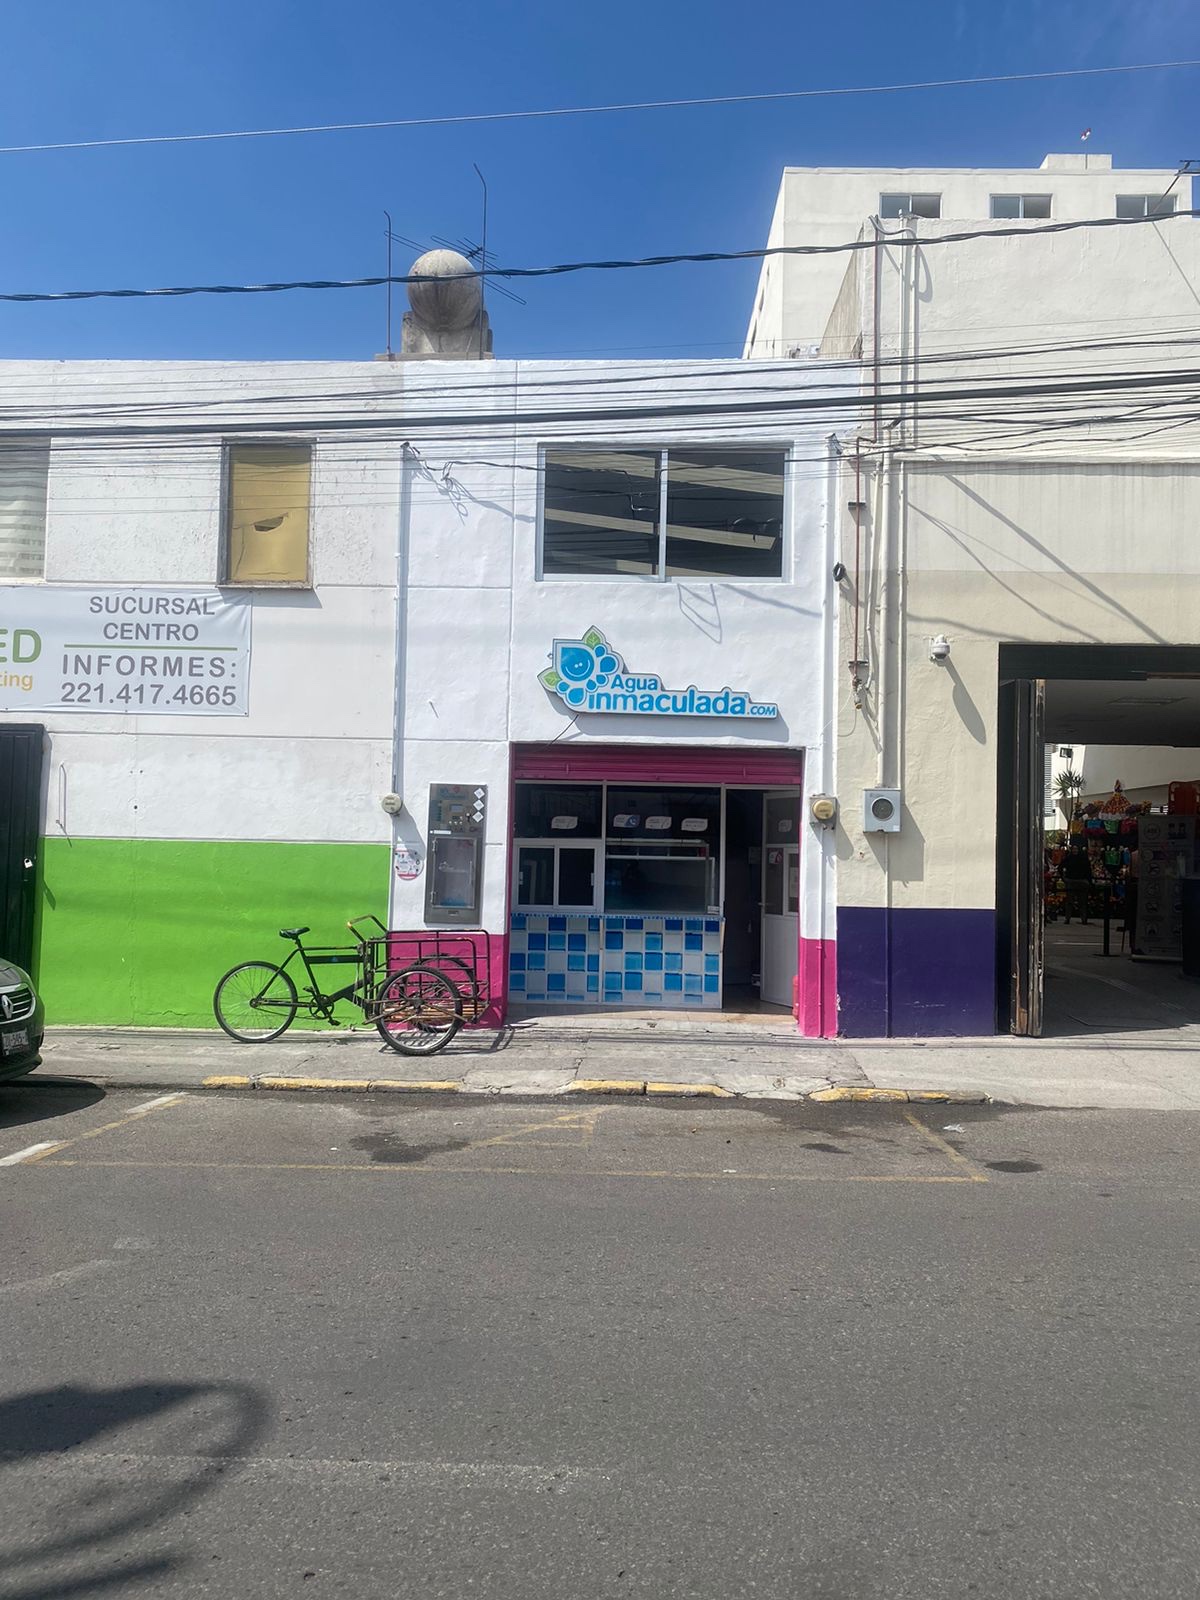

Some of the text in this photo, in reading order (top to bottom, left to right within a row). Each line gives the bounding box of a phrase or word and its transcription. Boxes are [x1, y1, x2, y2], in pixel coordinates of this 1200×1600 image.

[89, 596, 215, 615] SUCURSAL
[103, 622, 199, 641] CENTRO
[62, 654, 237, 678] INFORMES:
[610, 674, 658, 692] Agua
[60, 682, 237, 706] 221.417.4665
